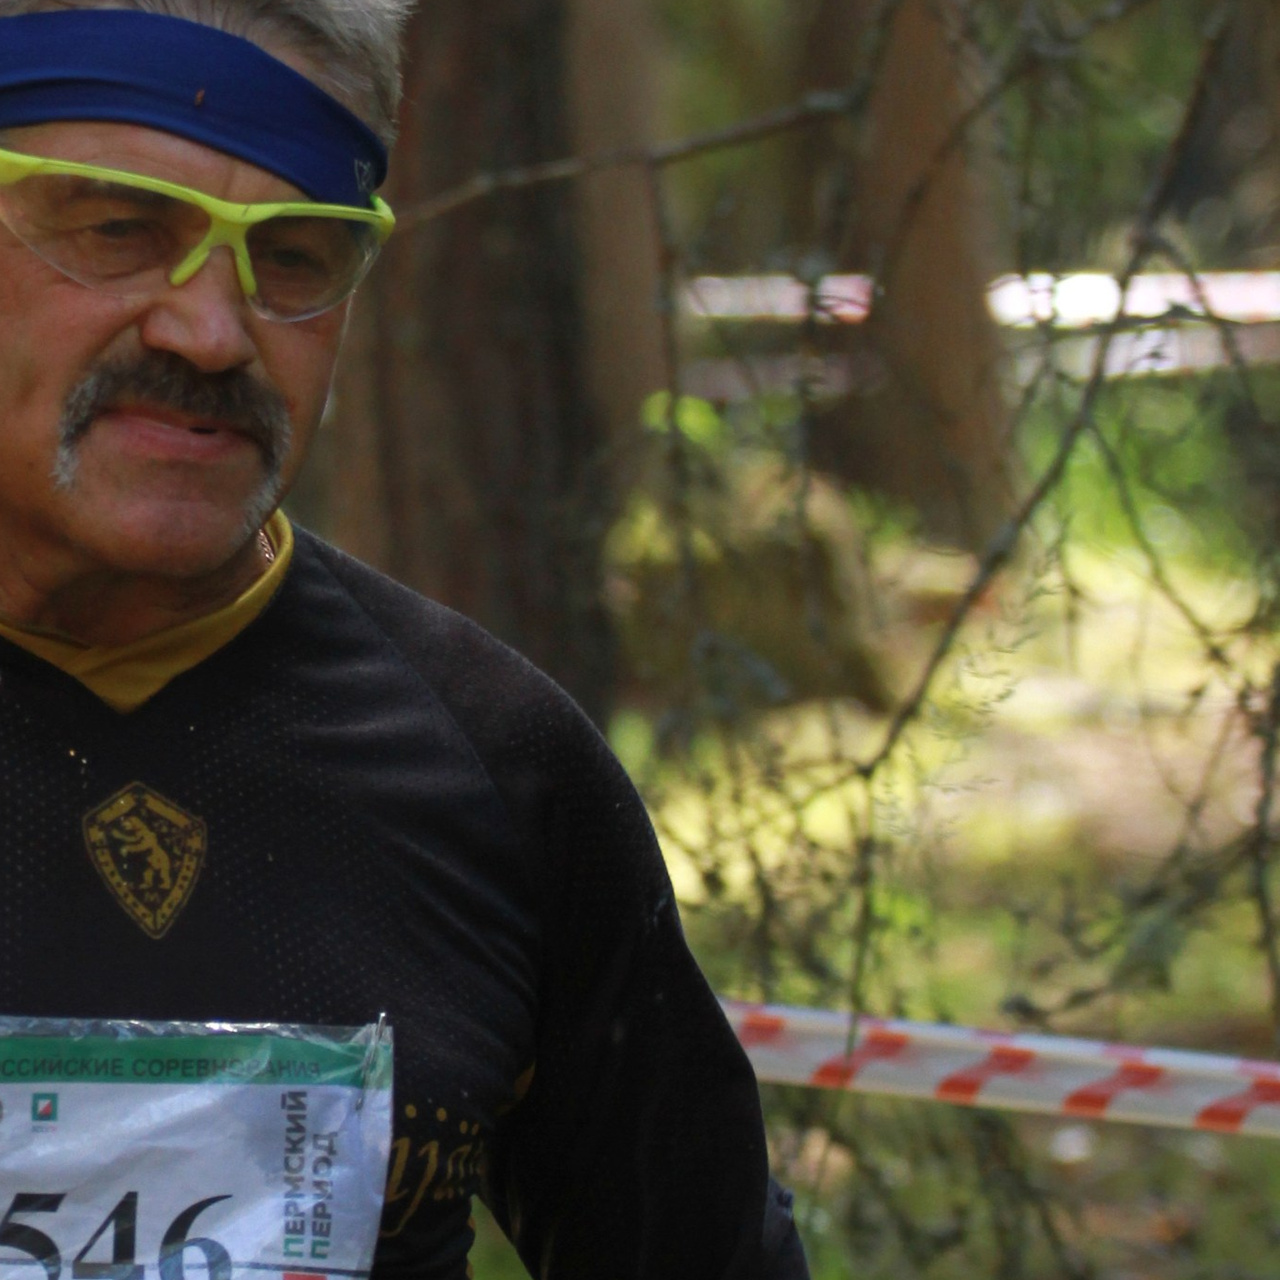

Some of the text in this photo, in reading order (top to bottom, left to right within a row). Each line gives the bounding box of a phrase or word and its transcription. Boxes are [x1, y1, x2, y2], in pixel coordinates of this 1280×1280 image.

[131, 1056, 321, 1080] СОРЕВНОВАНИЯ
[281, 1091, 308, 1258] ПЕРМСКИЙ
[310, 1131, 338, 1259] ПЕРИОД
